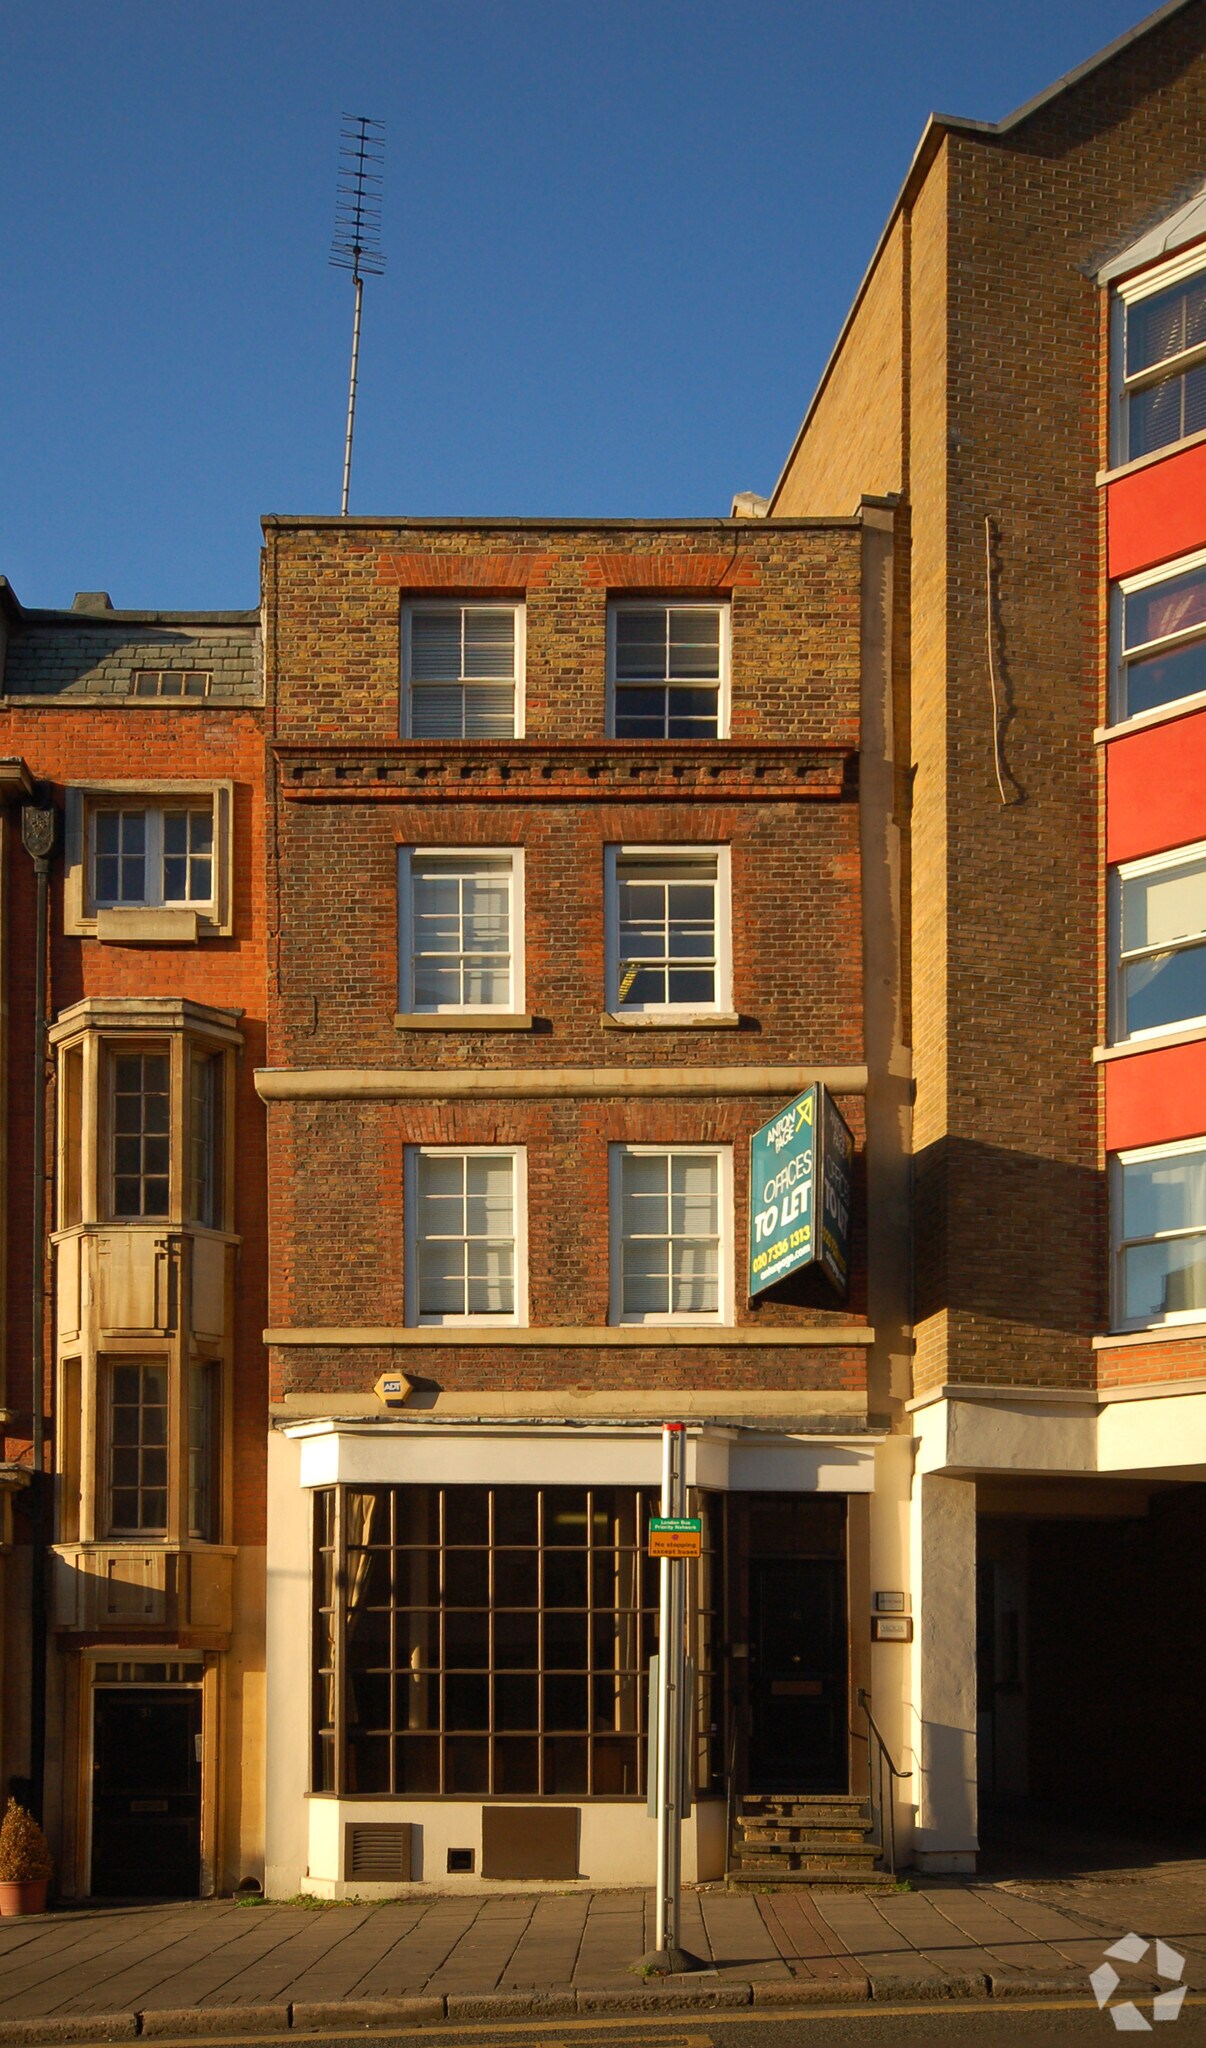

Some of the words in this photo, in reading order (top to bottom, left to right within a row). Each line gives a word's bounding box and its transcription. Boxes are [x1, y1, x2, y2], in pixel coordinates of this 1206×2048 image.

[767, 1108, 796, 1147] ANTON
[775, 1124, 794, 1154] PAGE
[763, 1149, 812, 1204] OFFICES
[755, 1205, 779, 1243] TO
[781, 1179, 812, 1227] LET
[753, 1252, 768, 1273] 020
[767, 1238, 789, 1263] 7336
[790, 1225, 811, 1248] 1313
[384, 1382, 401, 1391] ADT
[666, 1541, 696, 1549] stopping
